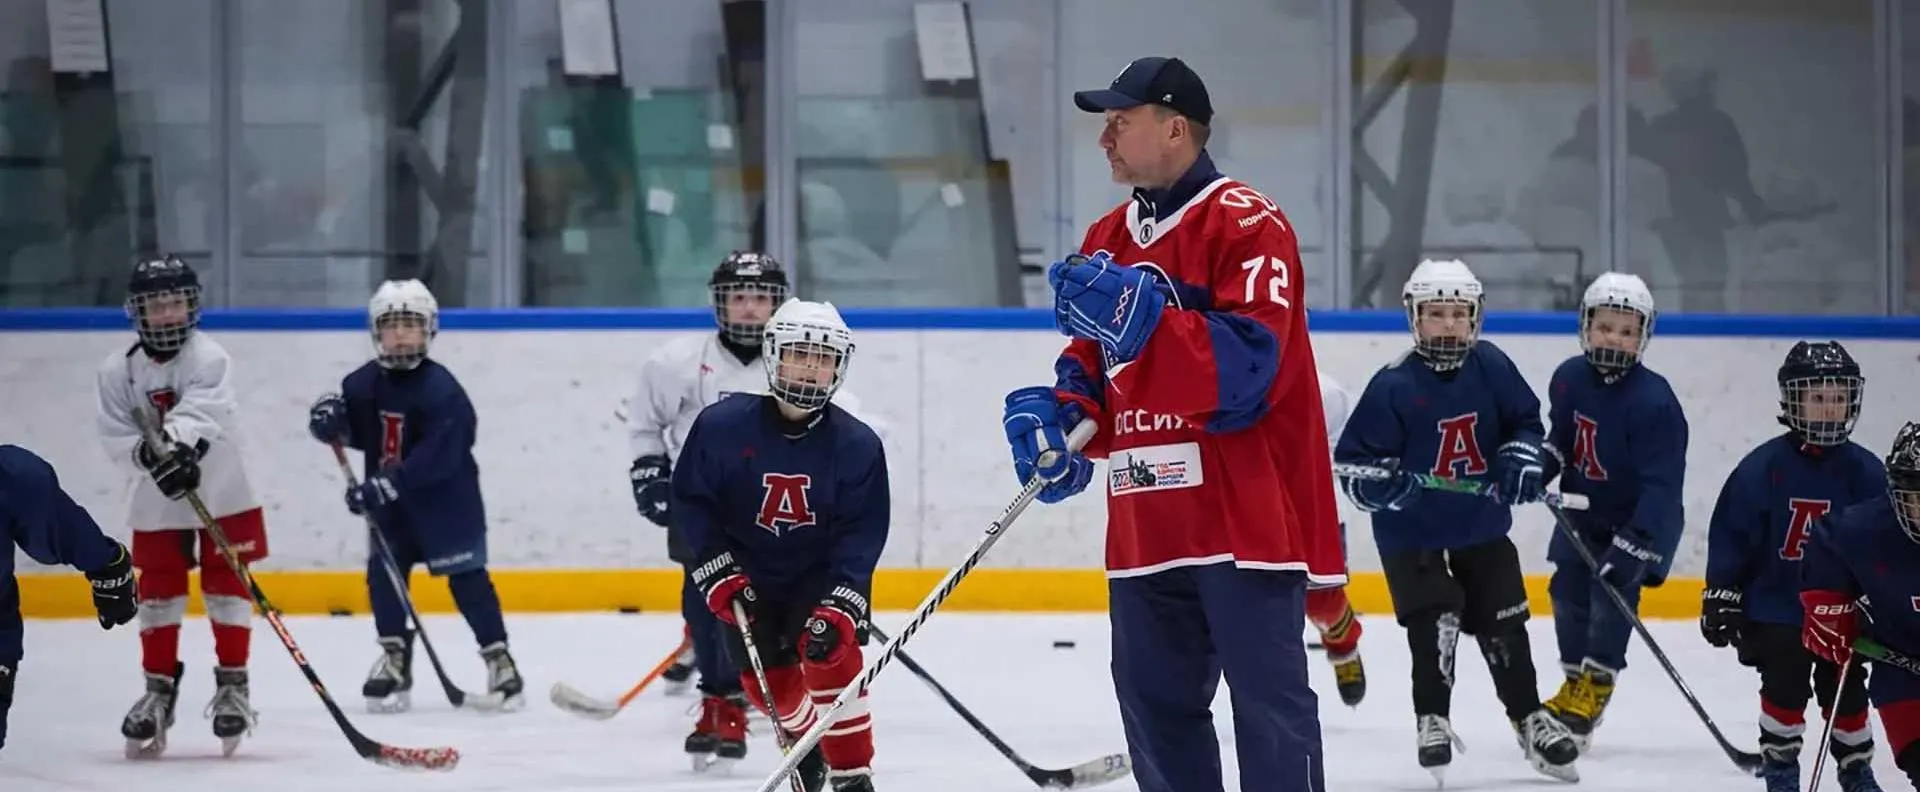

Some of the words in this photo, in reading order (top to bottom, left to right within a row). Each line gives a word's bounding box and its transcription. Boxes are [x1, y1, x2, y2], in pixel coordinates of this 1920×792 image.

[1241, 255, 1290, 309] 72
[1430, 411, 1488, 480] A
[1573, 409, 1608, 481] A
[755, 472, 817, 537] A
